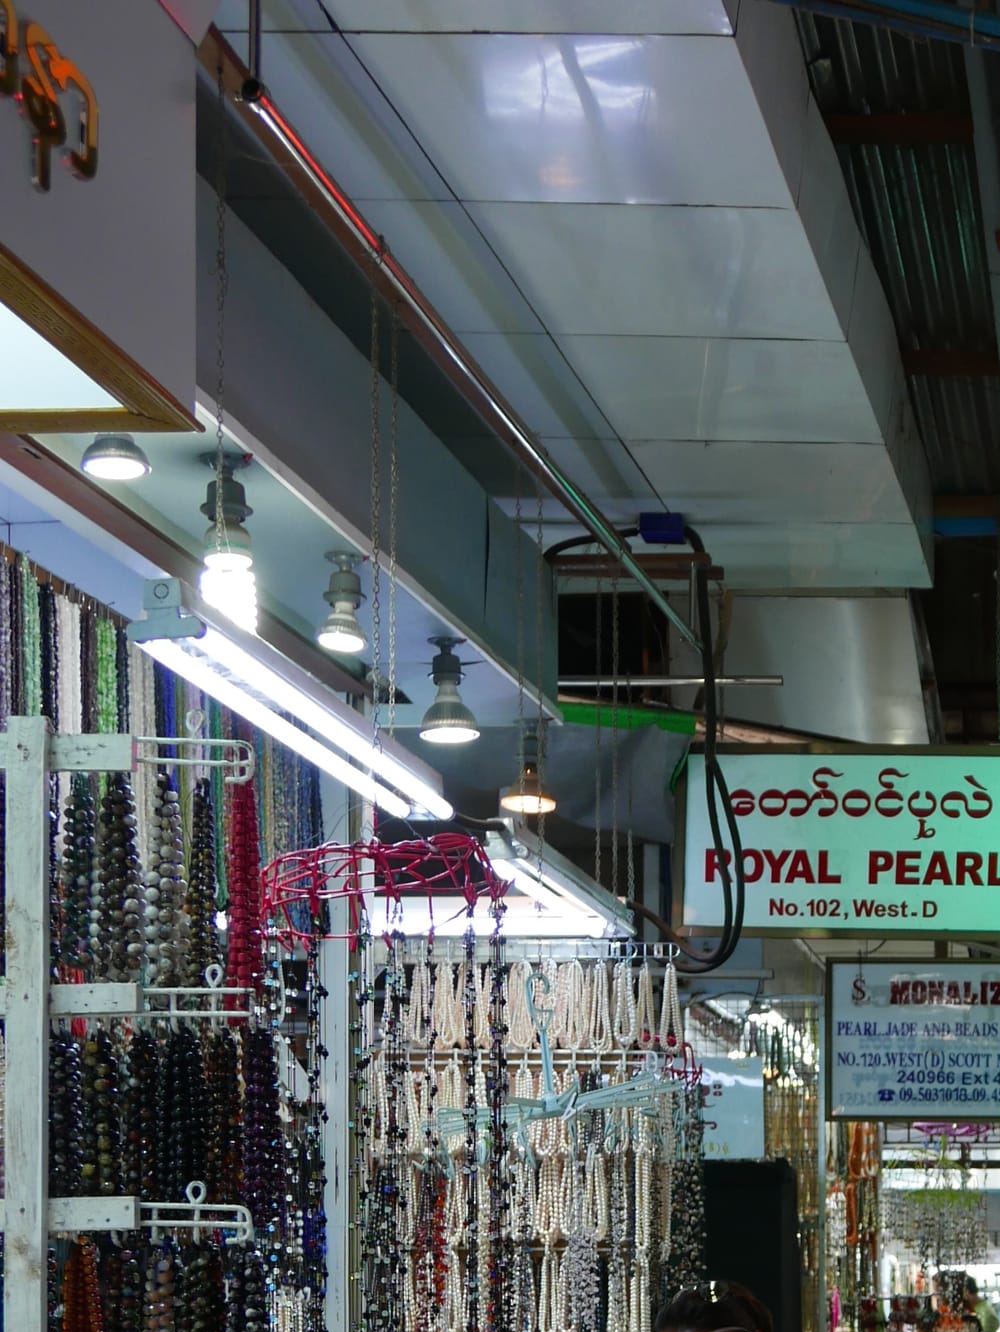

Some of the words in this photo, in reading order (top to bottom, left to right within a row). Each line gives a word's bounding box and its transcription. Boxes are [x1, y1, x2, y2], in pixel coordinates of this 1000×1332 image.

[704, 848, 842, 884] ROYAL
[922, 1022, 950, 1037] AND
[955, 1022, 999, 1037] BEADS
[949, 1053, 992, 1068] SCOTT
[897, 1070, 955, 1085] 240966
[961, 1072, 989, 1086] Ext
